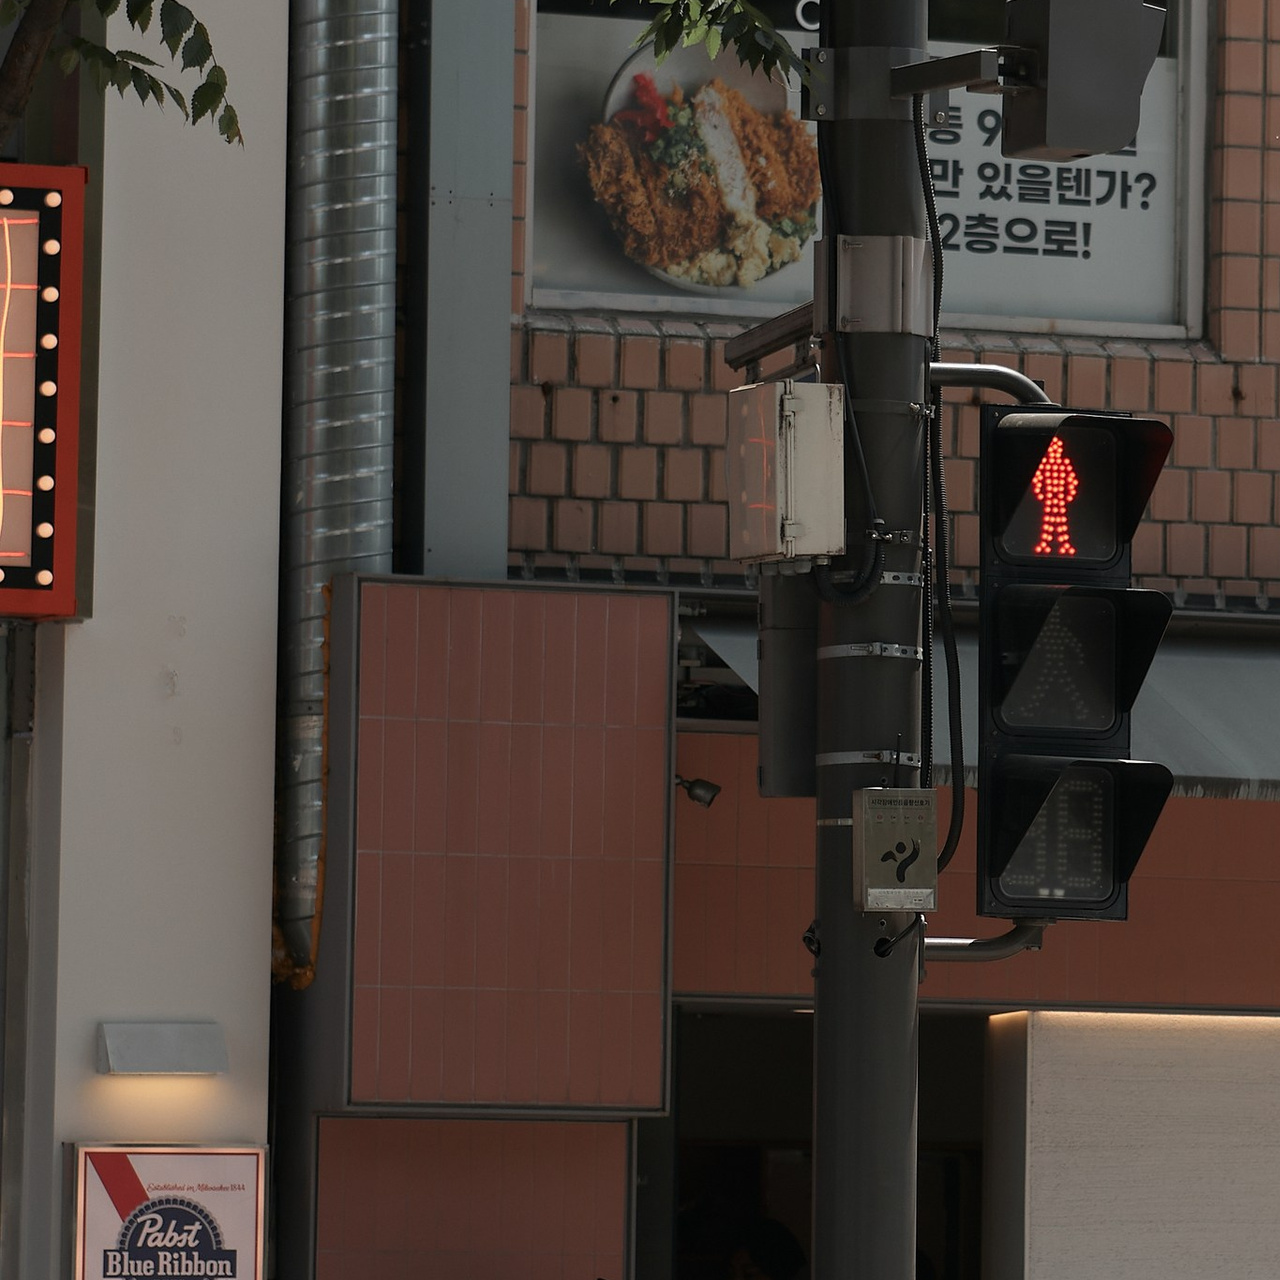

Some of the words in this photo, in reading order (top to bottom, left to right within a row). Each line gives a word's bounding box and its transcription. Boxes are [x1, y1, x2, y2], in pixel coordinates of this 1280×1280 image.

[977, 162, 1157, 210] 있을텐가?
[938, 213, 1092, 260] 2층으로!
[137, 1213, 202, 1248] Pabst
[106, 1251, 155, 1276] Blue
[158, 1251, 233, 1276] Ribbon
